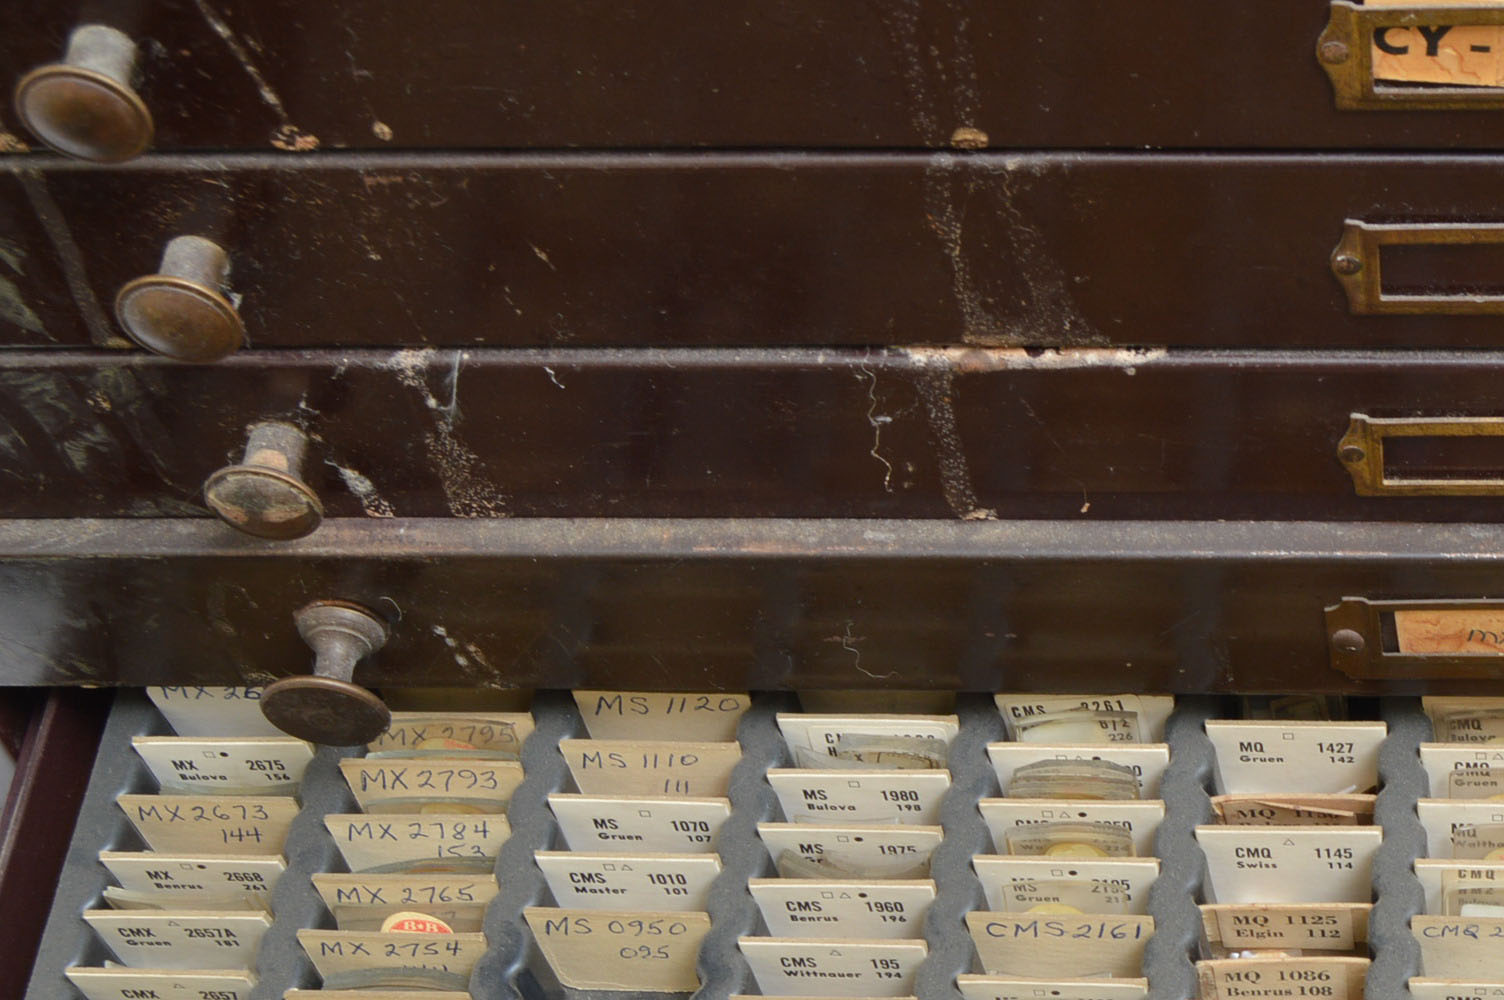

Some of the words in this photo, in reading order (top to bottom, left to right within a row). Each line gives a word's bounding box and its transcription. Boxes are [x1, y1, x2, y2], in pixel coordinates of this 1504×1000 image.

[1240, 742, 1264, 753] MQ
[1318, 743, 1353, 753] 1427
[171, 760, 198, 770] MX
[246, 760, 285, 771] 2675
[803, 790, 827, 800] MS
[881, 791, 918, 801] 1980
[593, 819, 618, 829] MS
[671, 821, 709, 832] 1070
[1235, 848, 1272, 858] CMQ
[1315, 848, 1352, 859] 1145
[786, 901, 822, 912] CMS
[866, 902, 904, 912] 1960
[1233, 916, 1271, 927] MQ
[118, 928, 156, 937] CMX
[184, 928, 236, 938] 2657A
[1236, 929, 1284, 939] Elgin
[1308, 929, 1340, 938] 112
[780, 957, 816, 967] CMS
[871, 959, 899, 969] 195
